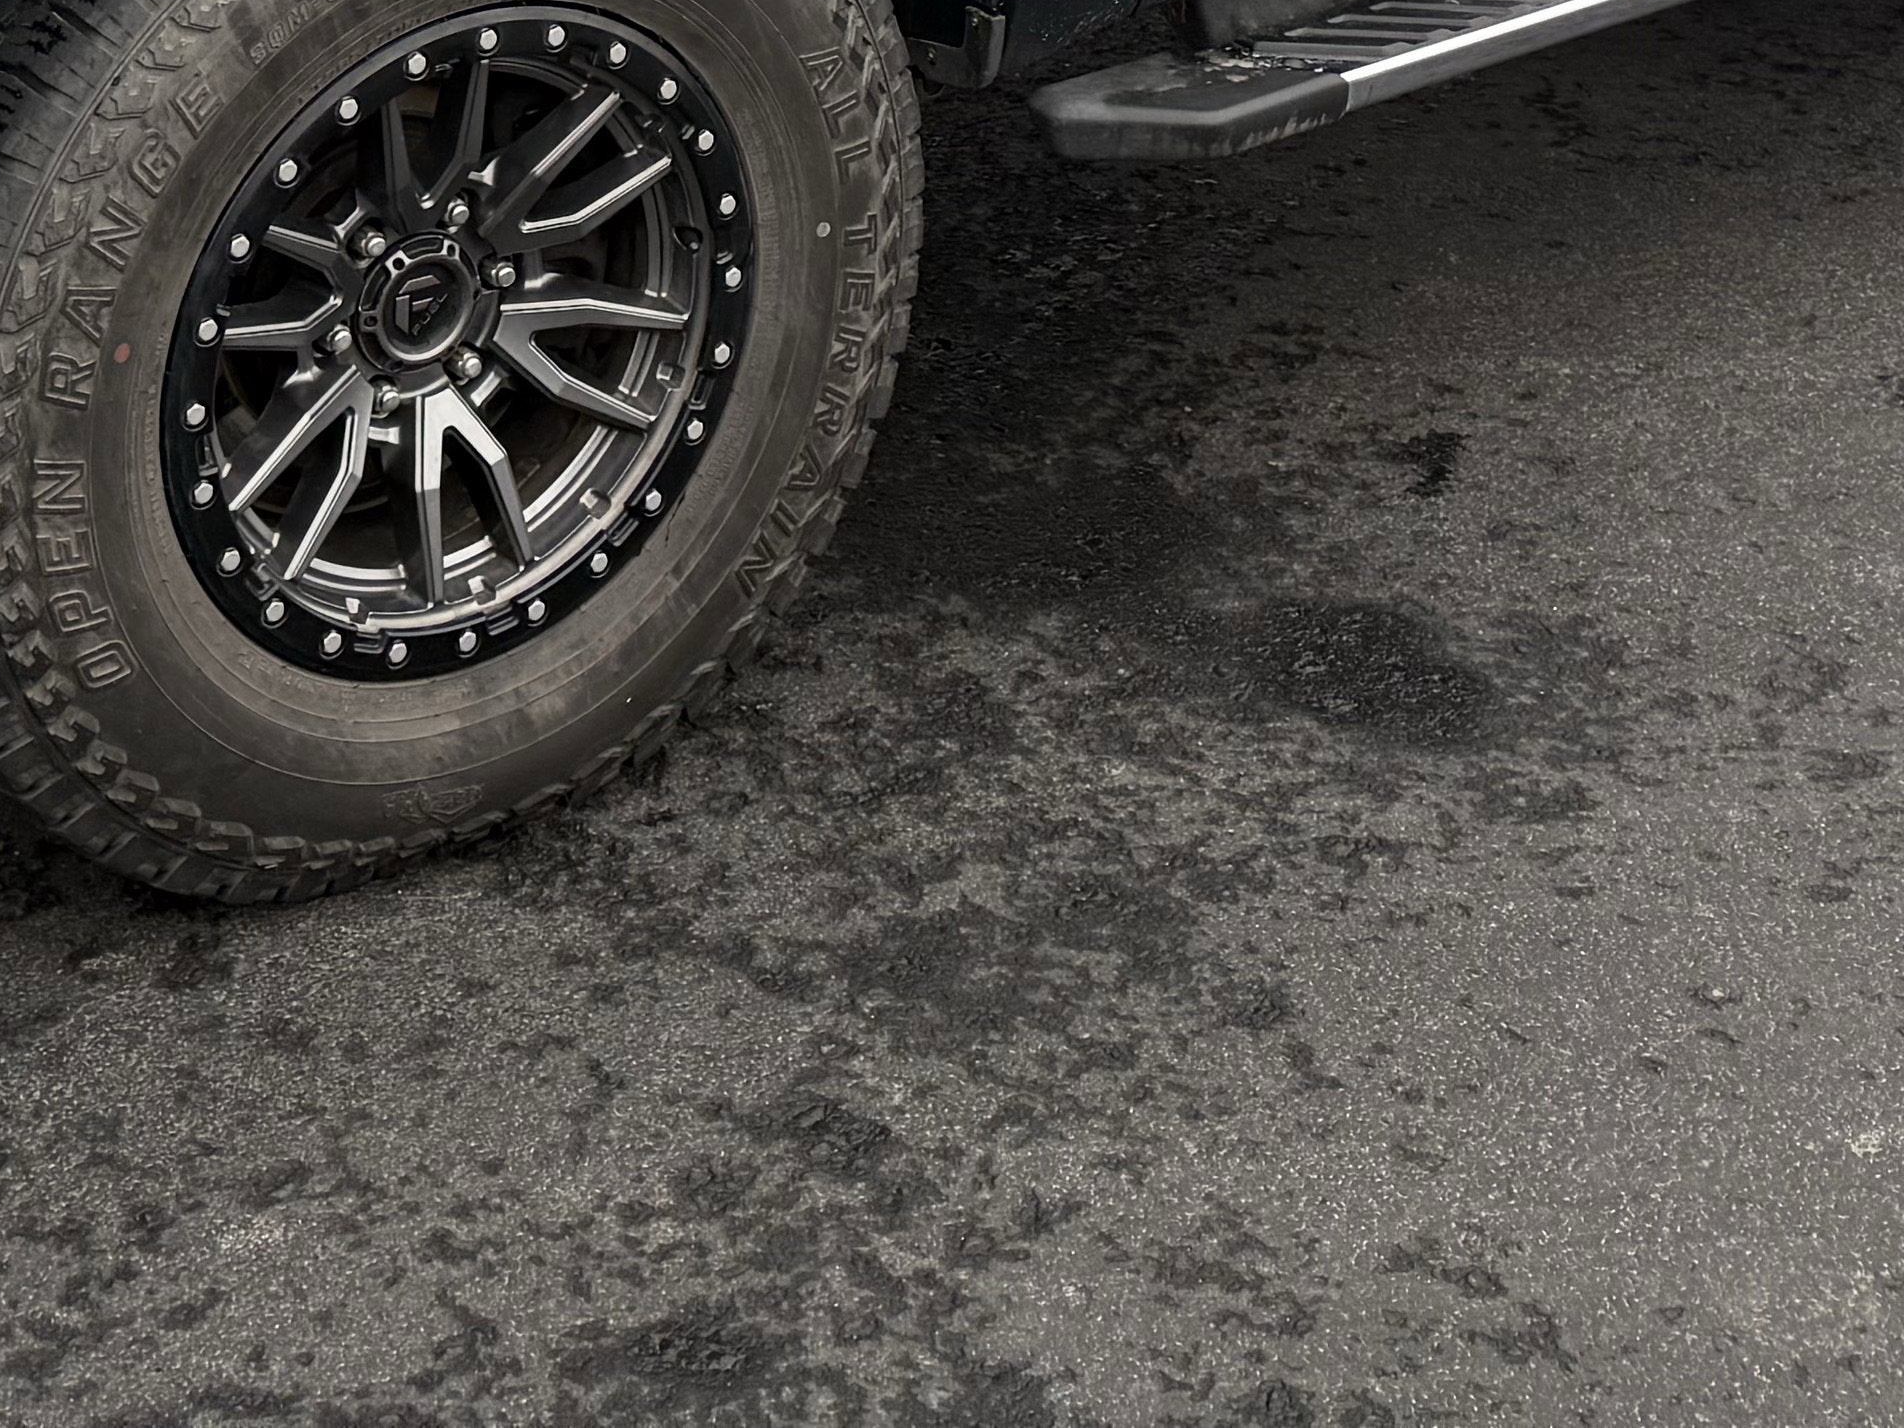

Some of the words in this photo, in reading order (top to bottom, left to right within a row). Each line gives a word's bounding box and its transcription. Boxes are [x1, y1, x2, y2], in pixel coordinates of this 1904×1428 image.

[39, 74, 225, 412] RANGE
[796, 45, 872, 186] ALL
[732, 211, 878, 599] TERRAIN
[33, 459, 138, 689] OPEN
